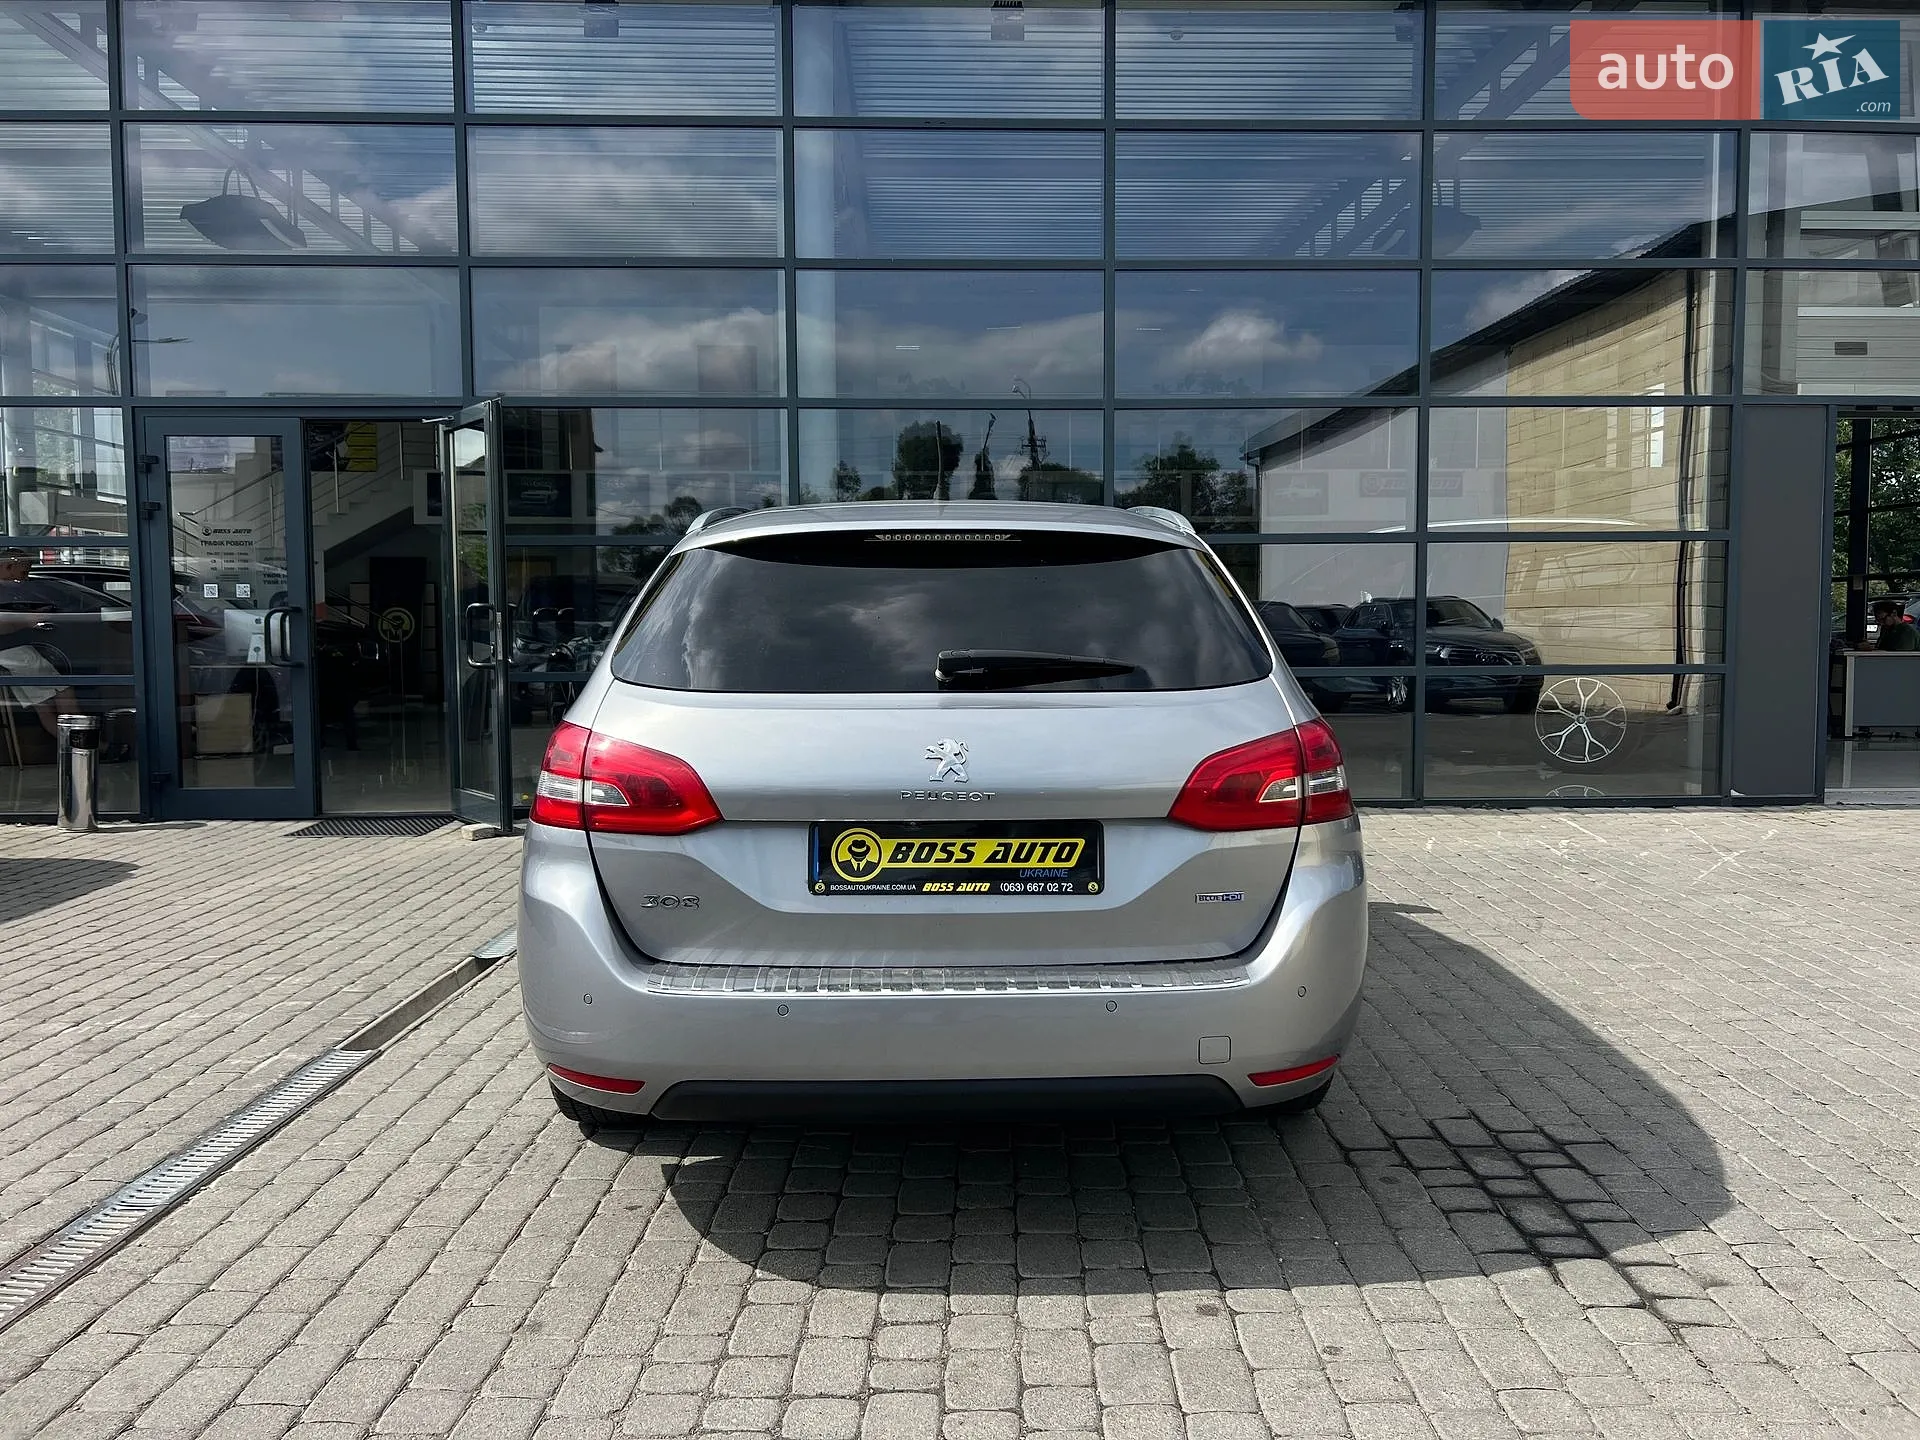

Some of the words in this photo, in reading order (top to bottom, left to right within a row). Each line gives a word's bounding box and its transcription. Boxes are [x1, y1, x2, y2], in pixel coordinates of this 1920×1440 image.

[900, 790, 996, 801] PEUGEOT
[887, 842, 977, 864] BOSS
[983, 842, 1080, 864] AUTO
[1019, 868, 1069, 878] UKRAINE
[922, 882, 954, 892] BOSS
[956, 882, 990, 892] AUTO
[1000, 882, 1024, 893] (063)
[1026, 882, 1044, 892] 667
[1046, 882, 1059, 892] 02
[1061, 882, 1073, 892] 72
[640, 894, 700, 909] 308
